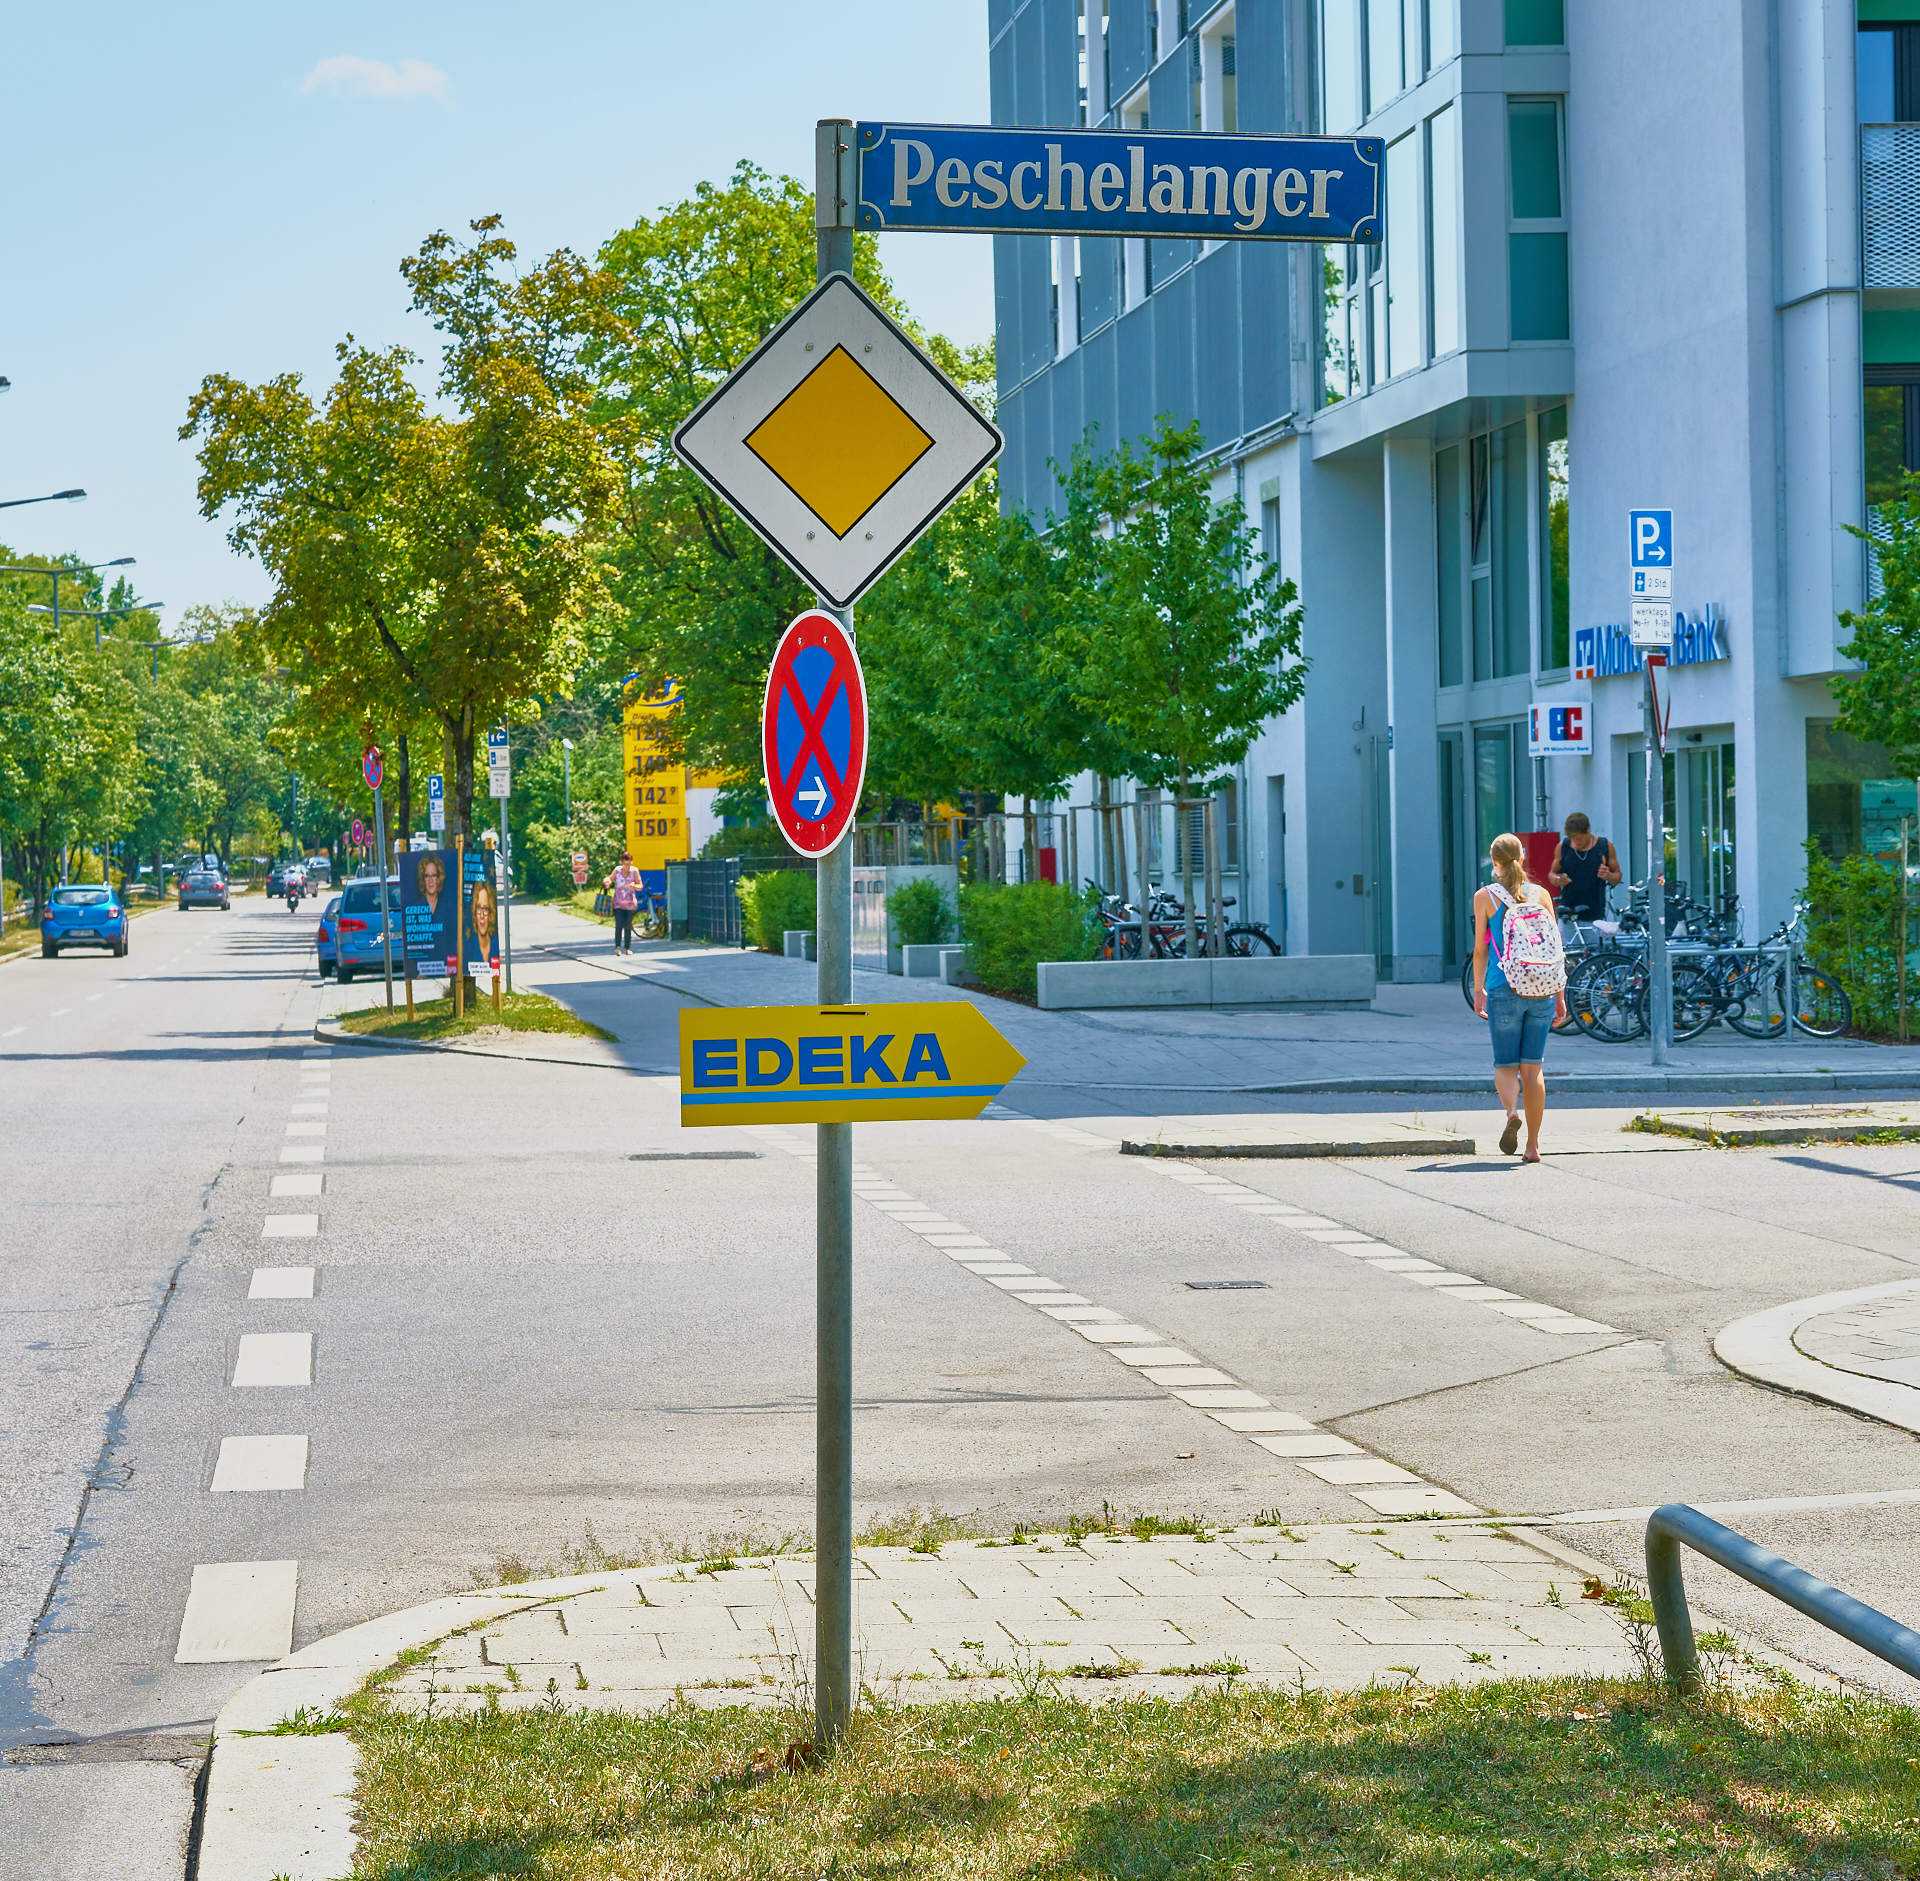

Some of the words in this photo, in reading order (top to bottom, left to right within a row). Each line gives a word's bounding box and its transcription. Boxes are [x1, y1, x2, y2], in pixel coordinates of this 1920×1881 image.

[889, 138, 1342, 231] Peschelanger
[1637, 517, 1660, 560] P
[1648, 578, 1653, 587] 2
[1636, 608, 1668, 618] werktags
[1676, 603, 1722, 666] Bank
[430, 778, 438, 796] P
[405, 905, 432, 915] GERECHT
[405, 915, 417, 924] IST,
[418, 914, 432, 923] WAS
[406, 923, 444, 933] WOHNRAUM
[406, 932, 434, 942] SCHAFFT.
[447, 966, 457, 974] SPD
[692, 1033, 951, 1088] EDEKA
